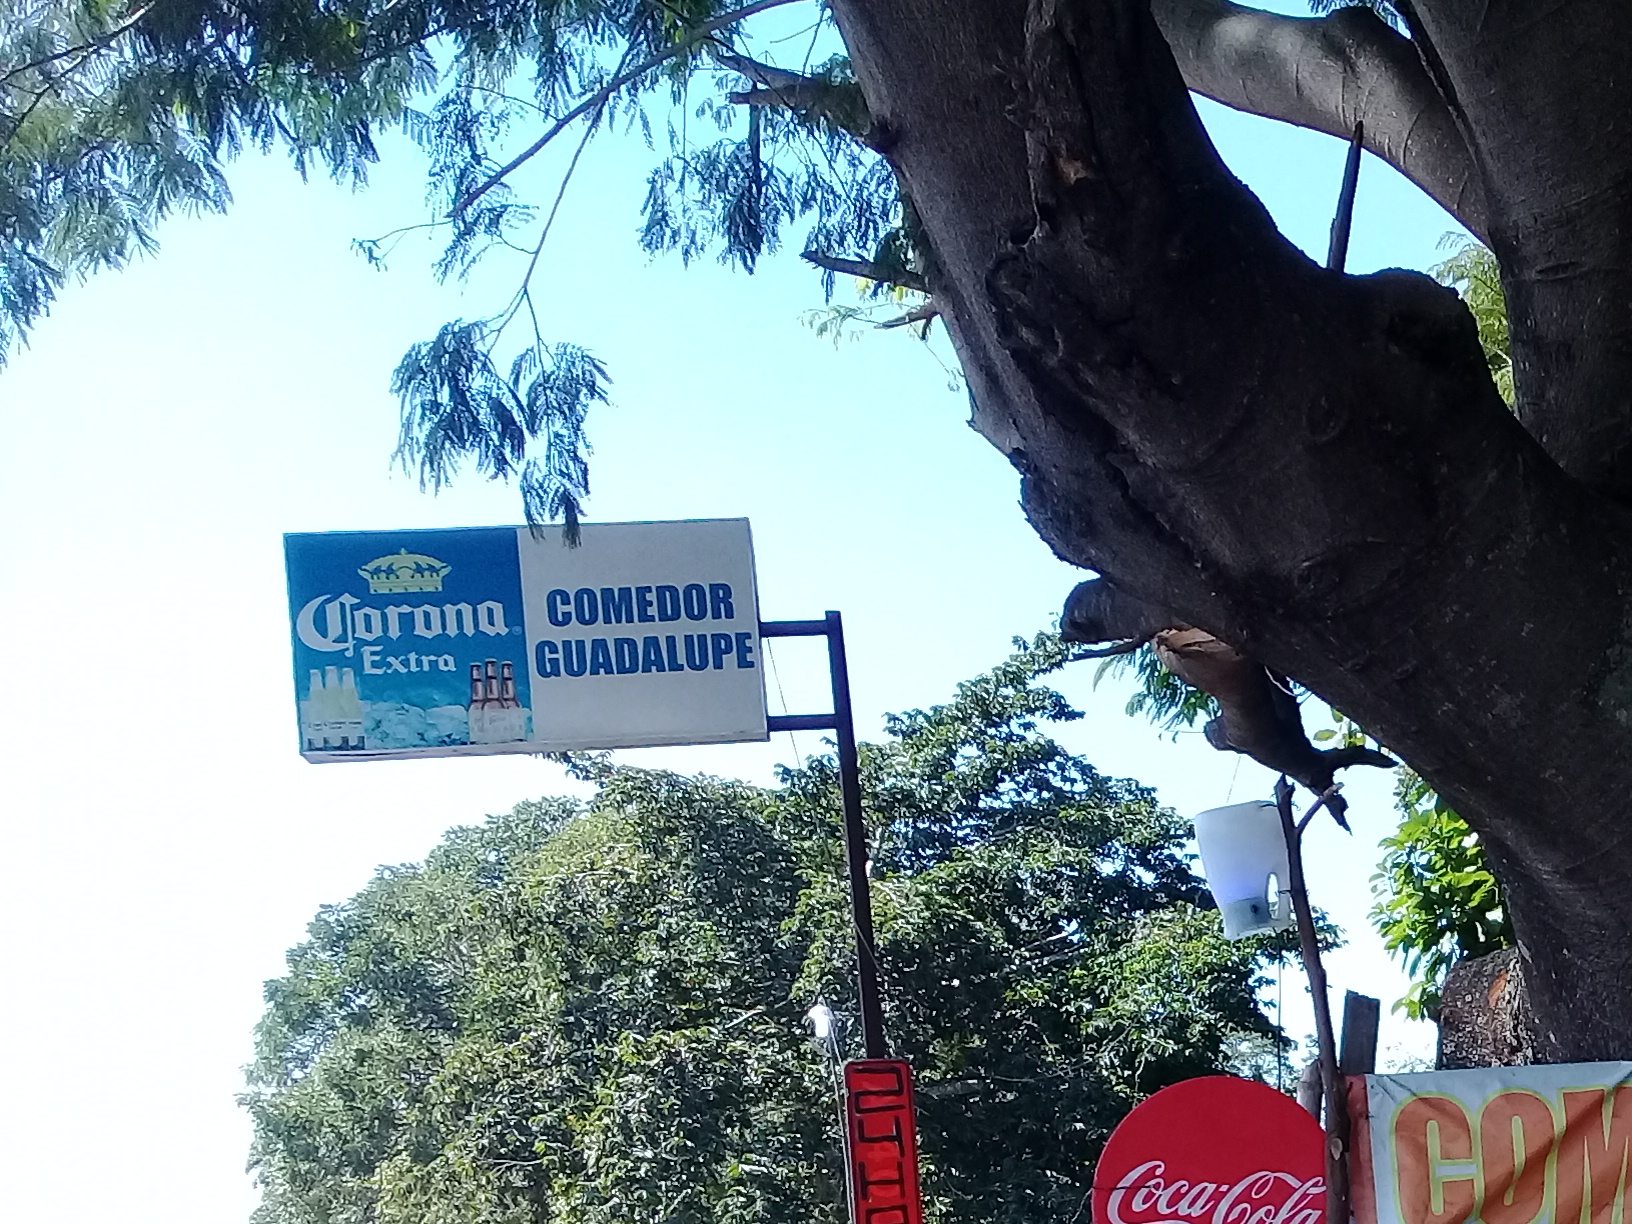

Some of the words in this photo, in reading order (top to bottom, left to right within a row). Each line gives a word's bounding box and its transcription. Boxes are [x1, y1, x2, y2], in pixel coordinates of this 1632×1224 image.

[296, 592, 510, 657] Corona
[546, 582, 735, 628] COMEDOR
[361, 645, 457, 675] Extra
[535, 632, 756, 679] GUADALUPE
